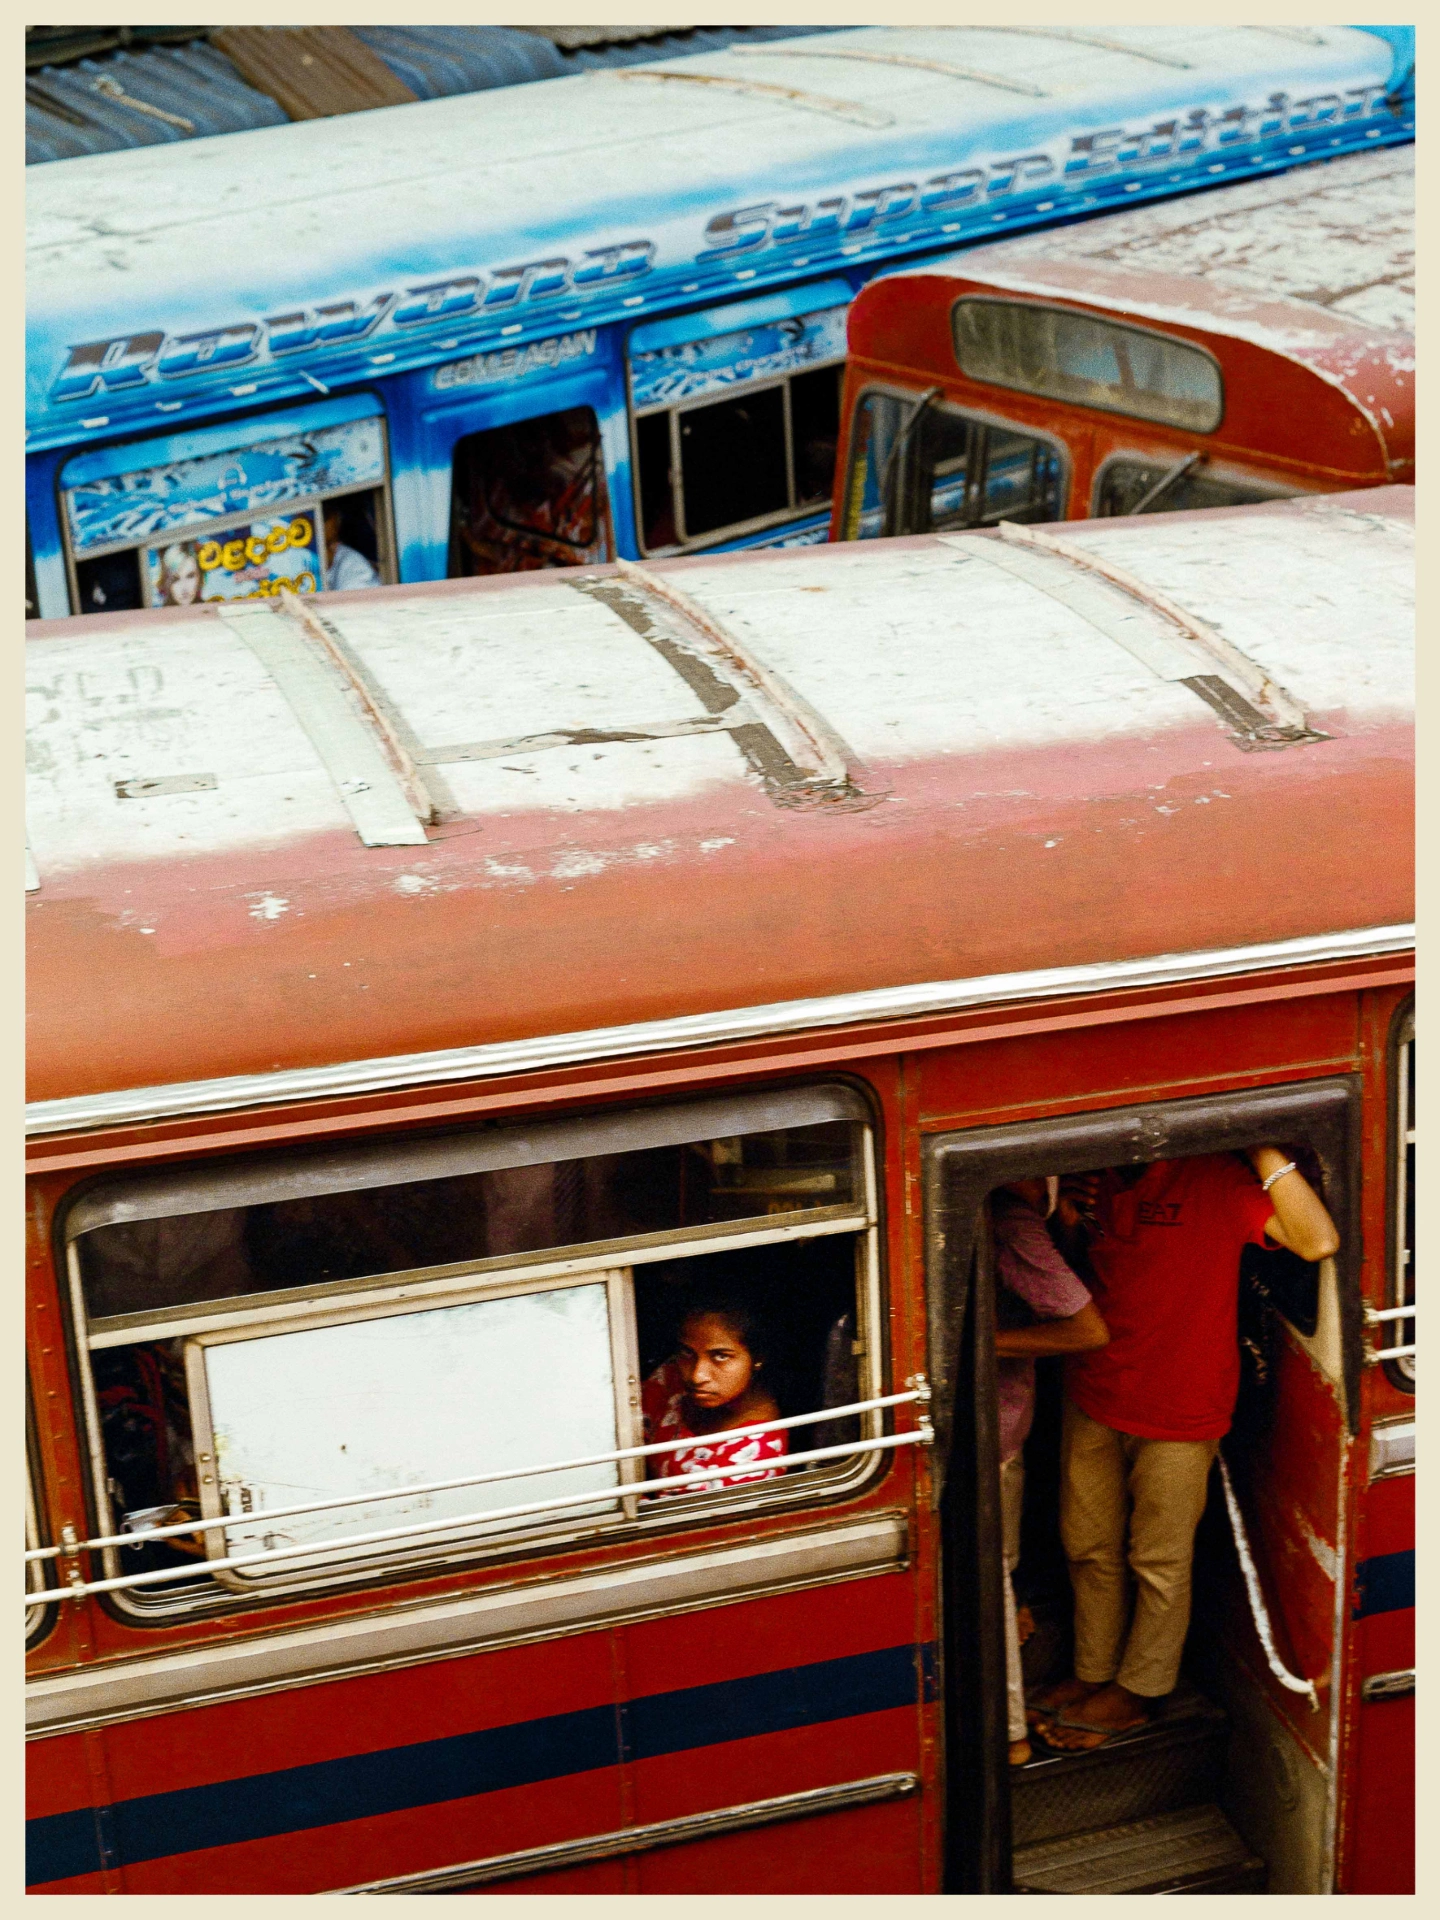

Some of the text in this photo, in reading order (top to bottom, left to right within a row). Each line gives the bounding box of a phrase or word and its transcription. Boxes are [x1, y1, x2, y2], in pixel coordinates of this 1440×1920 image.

[696, 154, 1054, 262] Super
[517, 328, 597, 376] AGAIN
[1138, 1201, 1182, 1221] EA7
